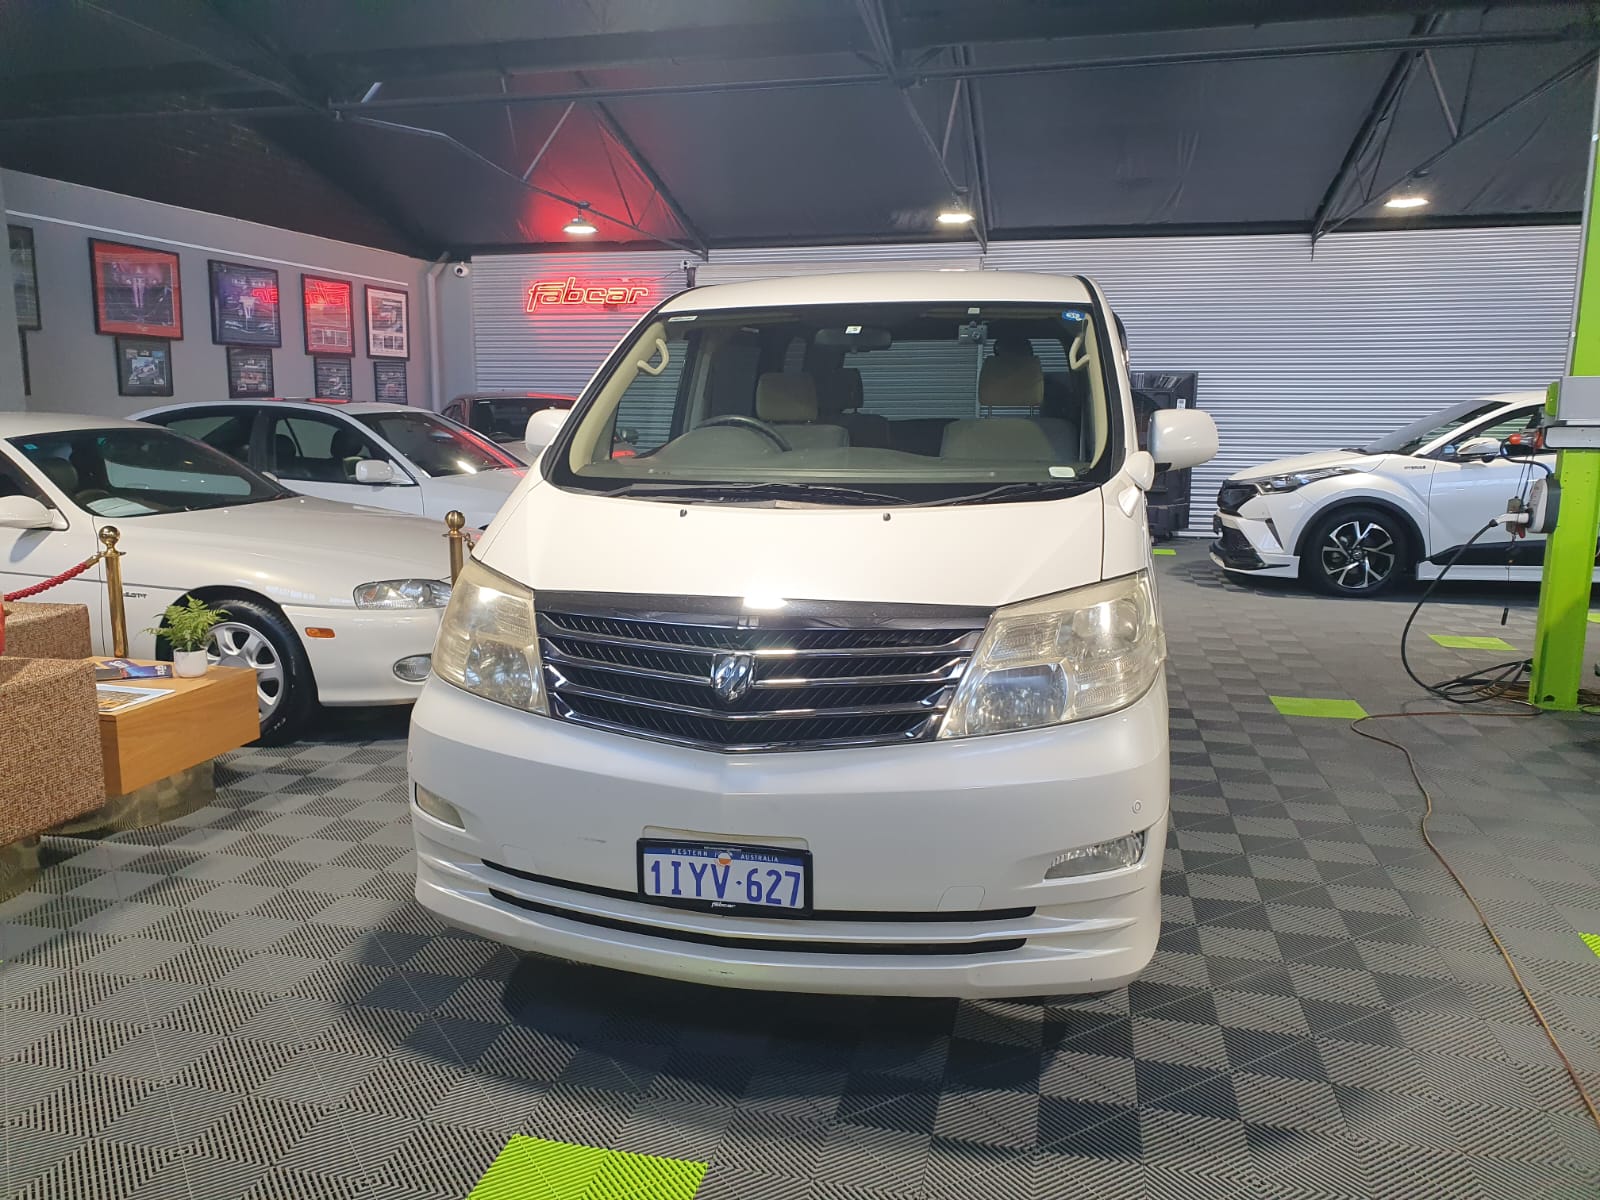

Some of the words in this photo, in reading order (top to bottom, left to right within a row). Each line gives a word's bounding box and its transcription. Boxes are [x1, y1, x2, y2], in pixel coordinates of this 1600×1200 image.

[527, 277, 648, 312] fabcar
[671, 848, 708, 856] WESTERN
[740, 853, 779, 863] AUSTRALIA
